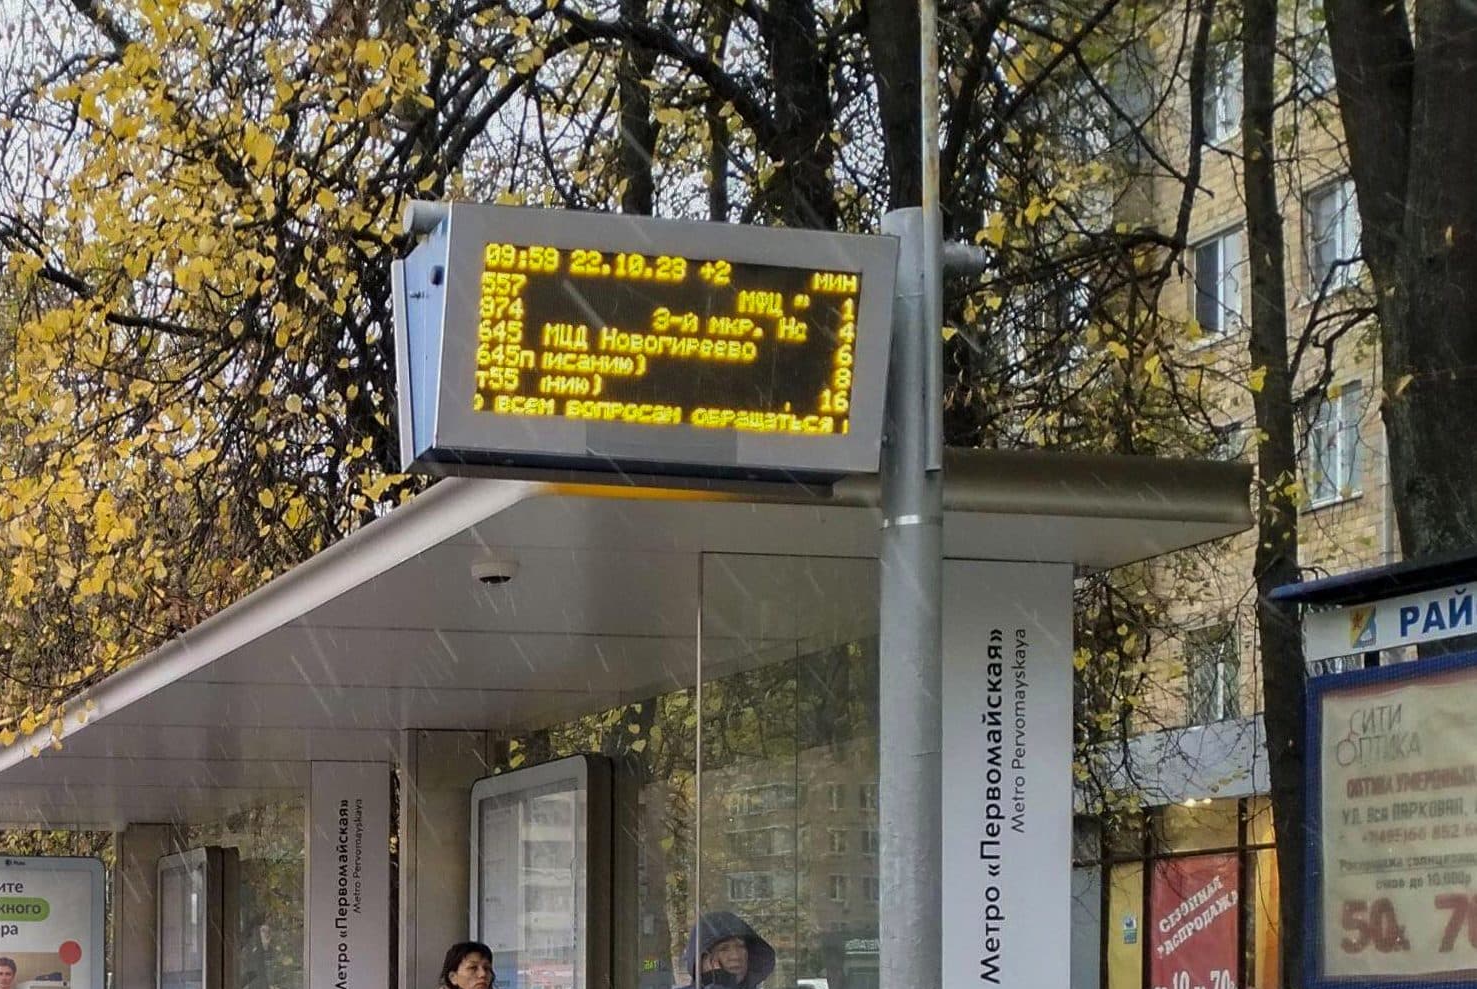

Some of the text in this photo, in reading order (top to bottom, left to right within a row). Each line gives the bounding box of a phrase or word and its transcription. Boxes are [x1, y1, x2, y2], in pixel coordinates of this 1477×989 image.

[570, 250, 687, 282] 22.10.23
[481, 271, 527, 297] 557
[841, 297, 854, 321] 1
[478, 319, 854, 367] 645 МЦД Новогиреево 6
[838, 321, 855, 343] 4
[819, 388, 848, 413] 16
[834, 367, 853, 390] 8
[1400, 588, 1477, 638] РАЙ
[1011, 629, 1026, 833] Metro Pervomayskaya
[980, 629, 1005, 985] Метро «Первомайская»
[335, 799, 350, 938] «Первомайская»
[353, 799, 363, 914] Metro Pervomayskaya
